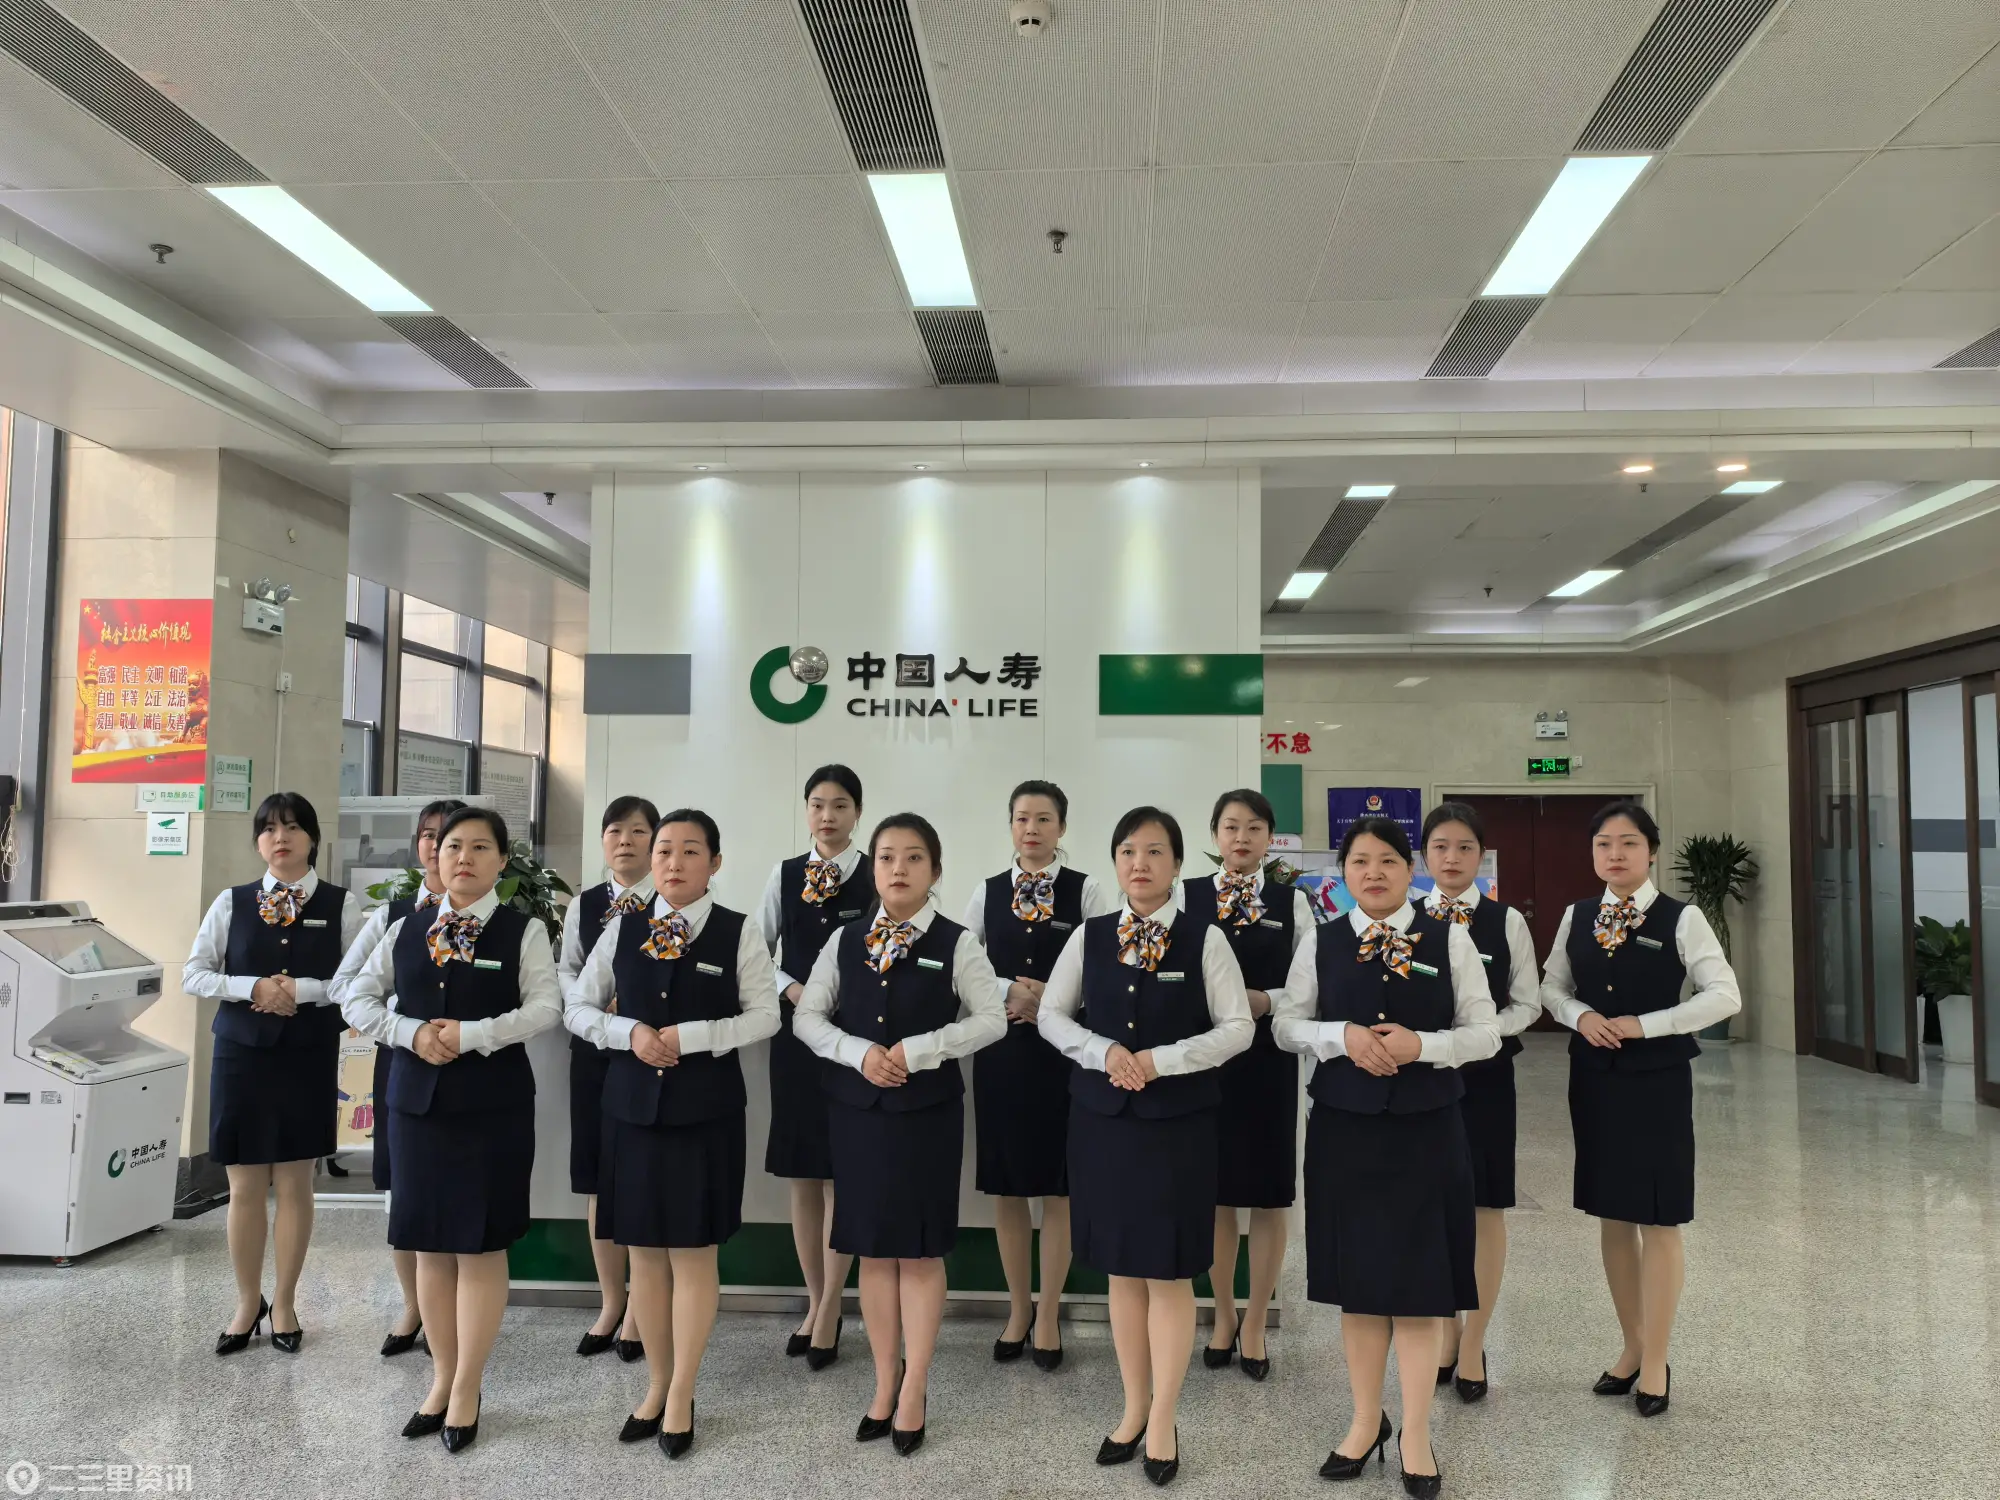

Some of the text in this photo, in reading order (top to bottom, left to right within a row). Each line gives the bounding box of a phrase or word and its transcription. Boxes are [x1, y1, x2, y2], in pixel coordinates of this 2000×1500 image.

[98, 666, 188, 684] 富强 民主 文明 和谐
[847, 651, 1041, 690] 中国人寿
[97, 690, 186, 707] 自由 平等 公正 法治
[847, 698, 1038, 717] CHINA LIFE
[96, 713, 186, 730] 爱国 敬业 诚信 友善
[1261, 731, 1312, 754] 不怠
[131, 1139, 167, 1159] 中国人寿
[130, 1151, 166, 1168] CHINA LIFE
